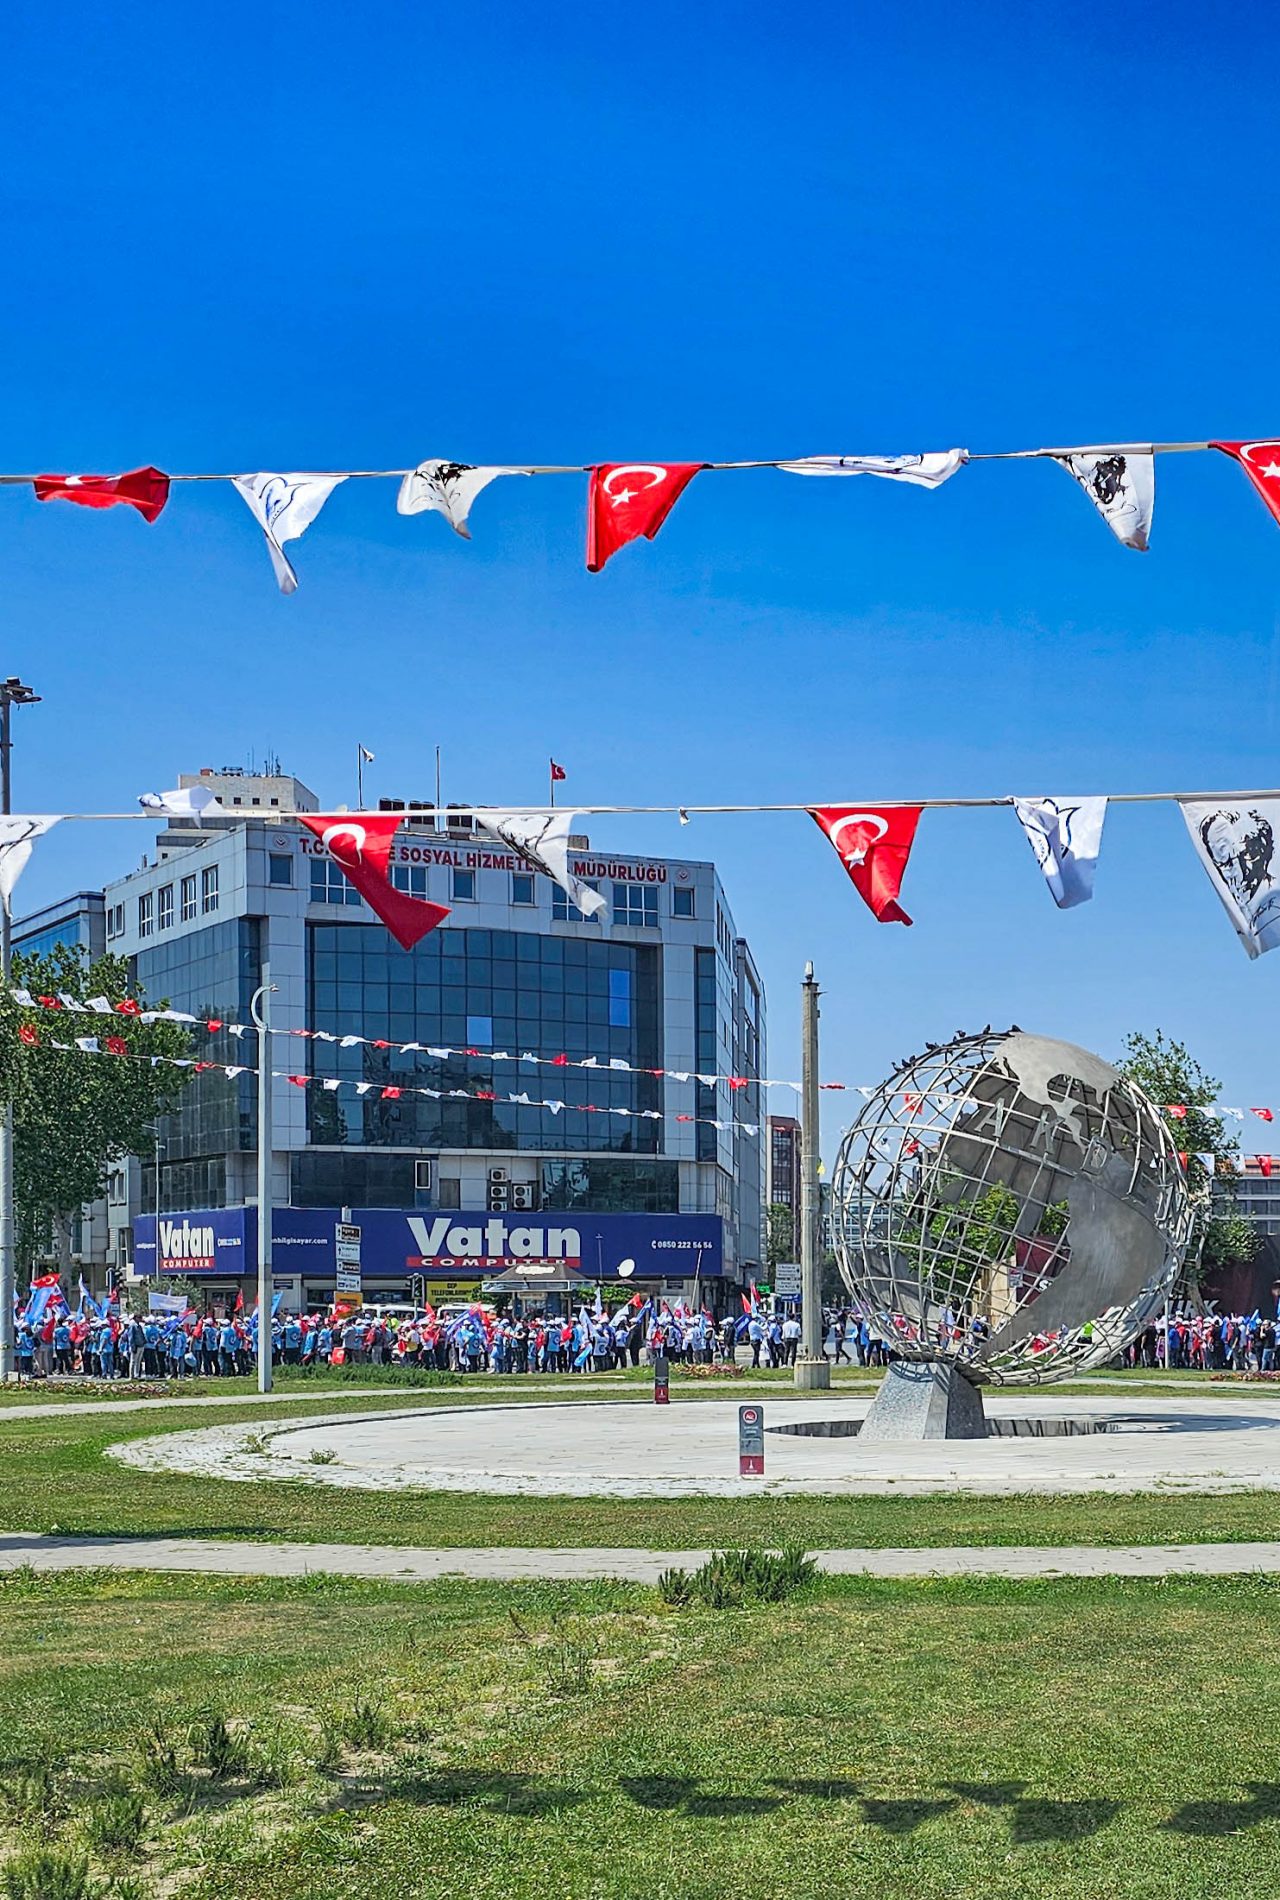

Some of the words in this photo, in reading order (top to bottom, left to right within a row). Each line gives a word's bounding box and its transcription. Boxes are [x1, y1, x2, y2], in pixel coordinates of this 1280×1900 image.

[400, 846, 462, 867] SOSYAL
[466, 848, 542, 872] HİZMETL
[574, 858, 667, 883] MÜDÜRLÜĞÜ
[159, 1219, 215, 1259] Vatan
[271, 1236, 328, 1246] nbilgisayar.com
[406, 1216, 581, 1258] Vatan
[657, 1240, 677, 1249] 0850
[677, 1240, 691, 1249] 222
[692, 1240, 702, 1249] 56
[703, 1240, 713, 1249] 56
[163, 1259, 211, 1269] COMPUTER
[420, 1258, 567, 1267] COMPUTER
